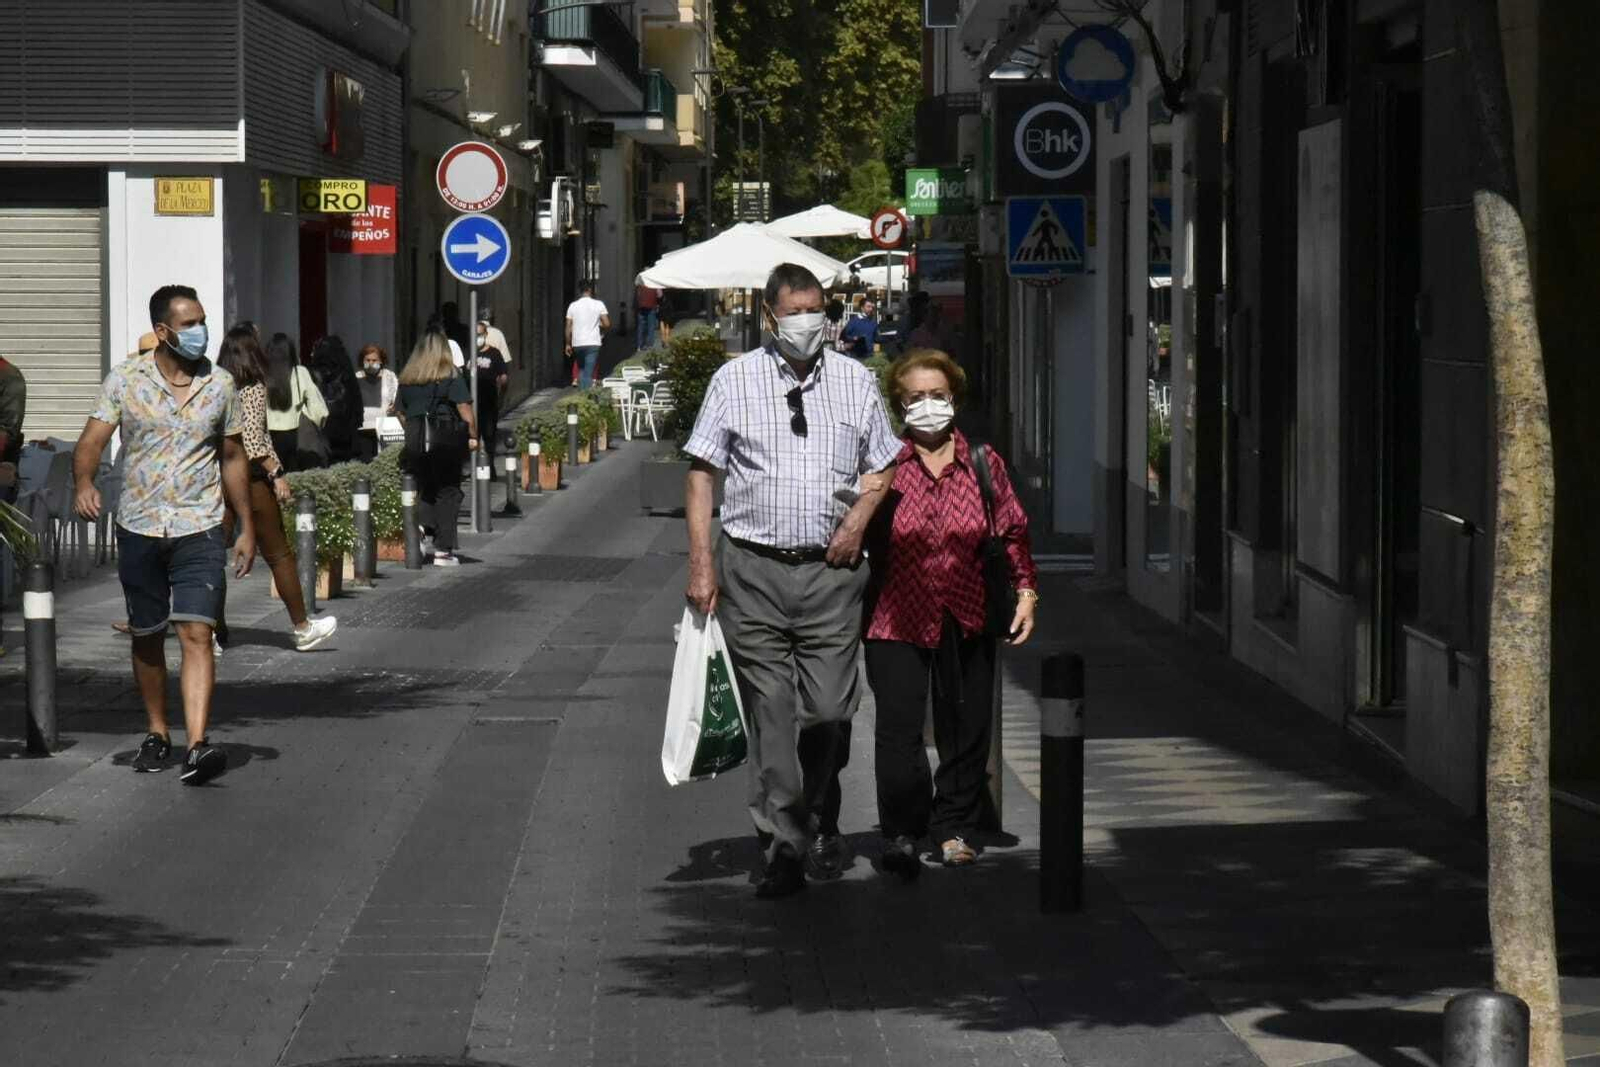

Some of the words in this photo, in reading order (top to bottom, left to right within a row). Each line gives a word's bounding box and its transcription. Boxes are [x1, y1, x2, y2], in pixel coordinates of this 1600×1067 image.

[1025, 128, 1078, 154] Bhk
[176, 181, 202, 194] PLAZA
[306, 182, 358, 190] COMPRO
[303, 192, 361, 210] ORO
[333, 228, 390, 242] EMPEÑOS
[461, 268, 493, 279] GARAJES
